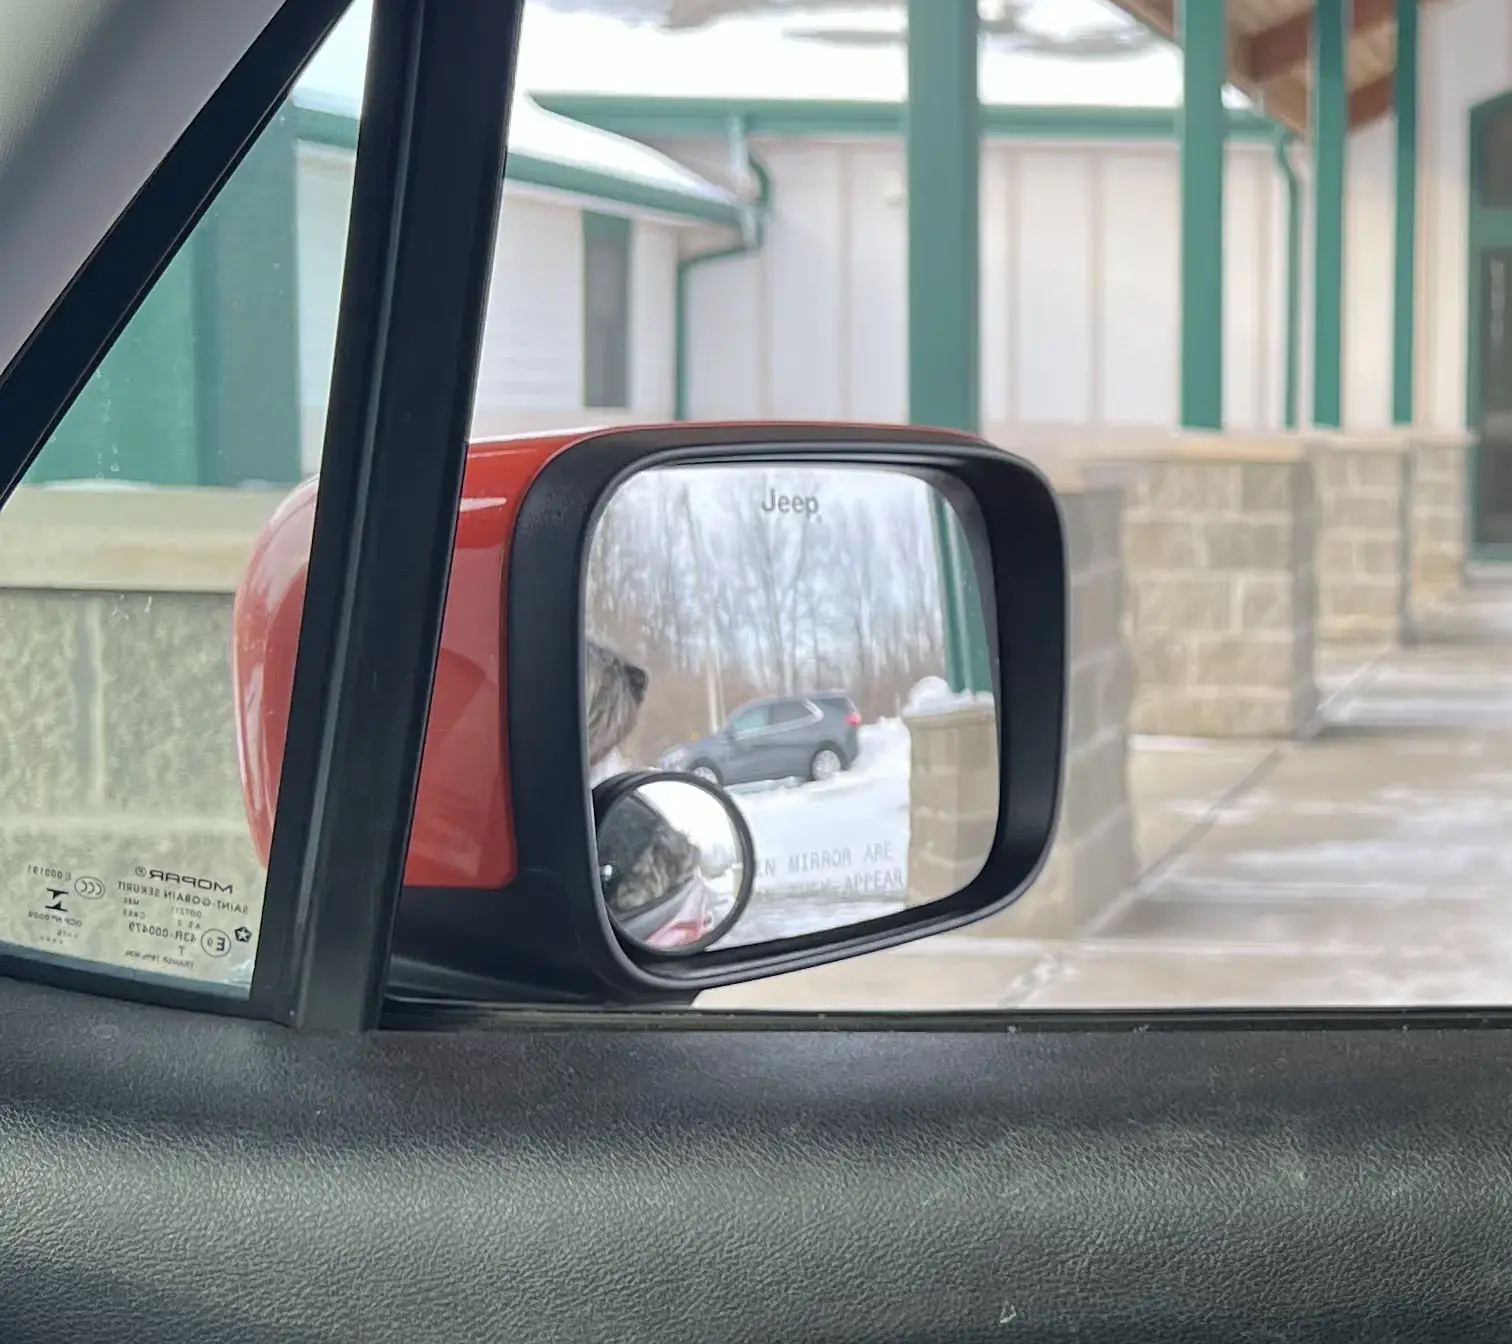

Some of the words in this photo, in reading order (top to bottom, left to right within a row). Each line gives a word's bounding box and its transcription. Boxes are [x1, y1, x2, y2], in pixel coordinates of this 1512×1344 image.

[761, 488, 819, 521] Jeep
[788, 847, 852, 872] MIRROR
[864, 840, 894, 863] ARE
[845, 868, 904, 893] APPEAR
